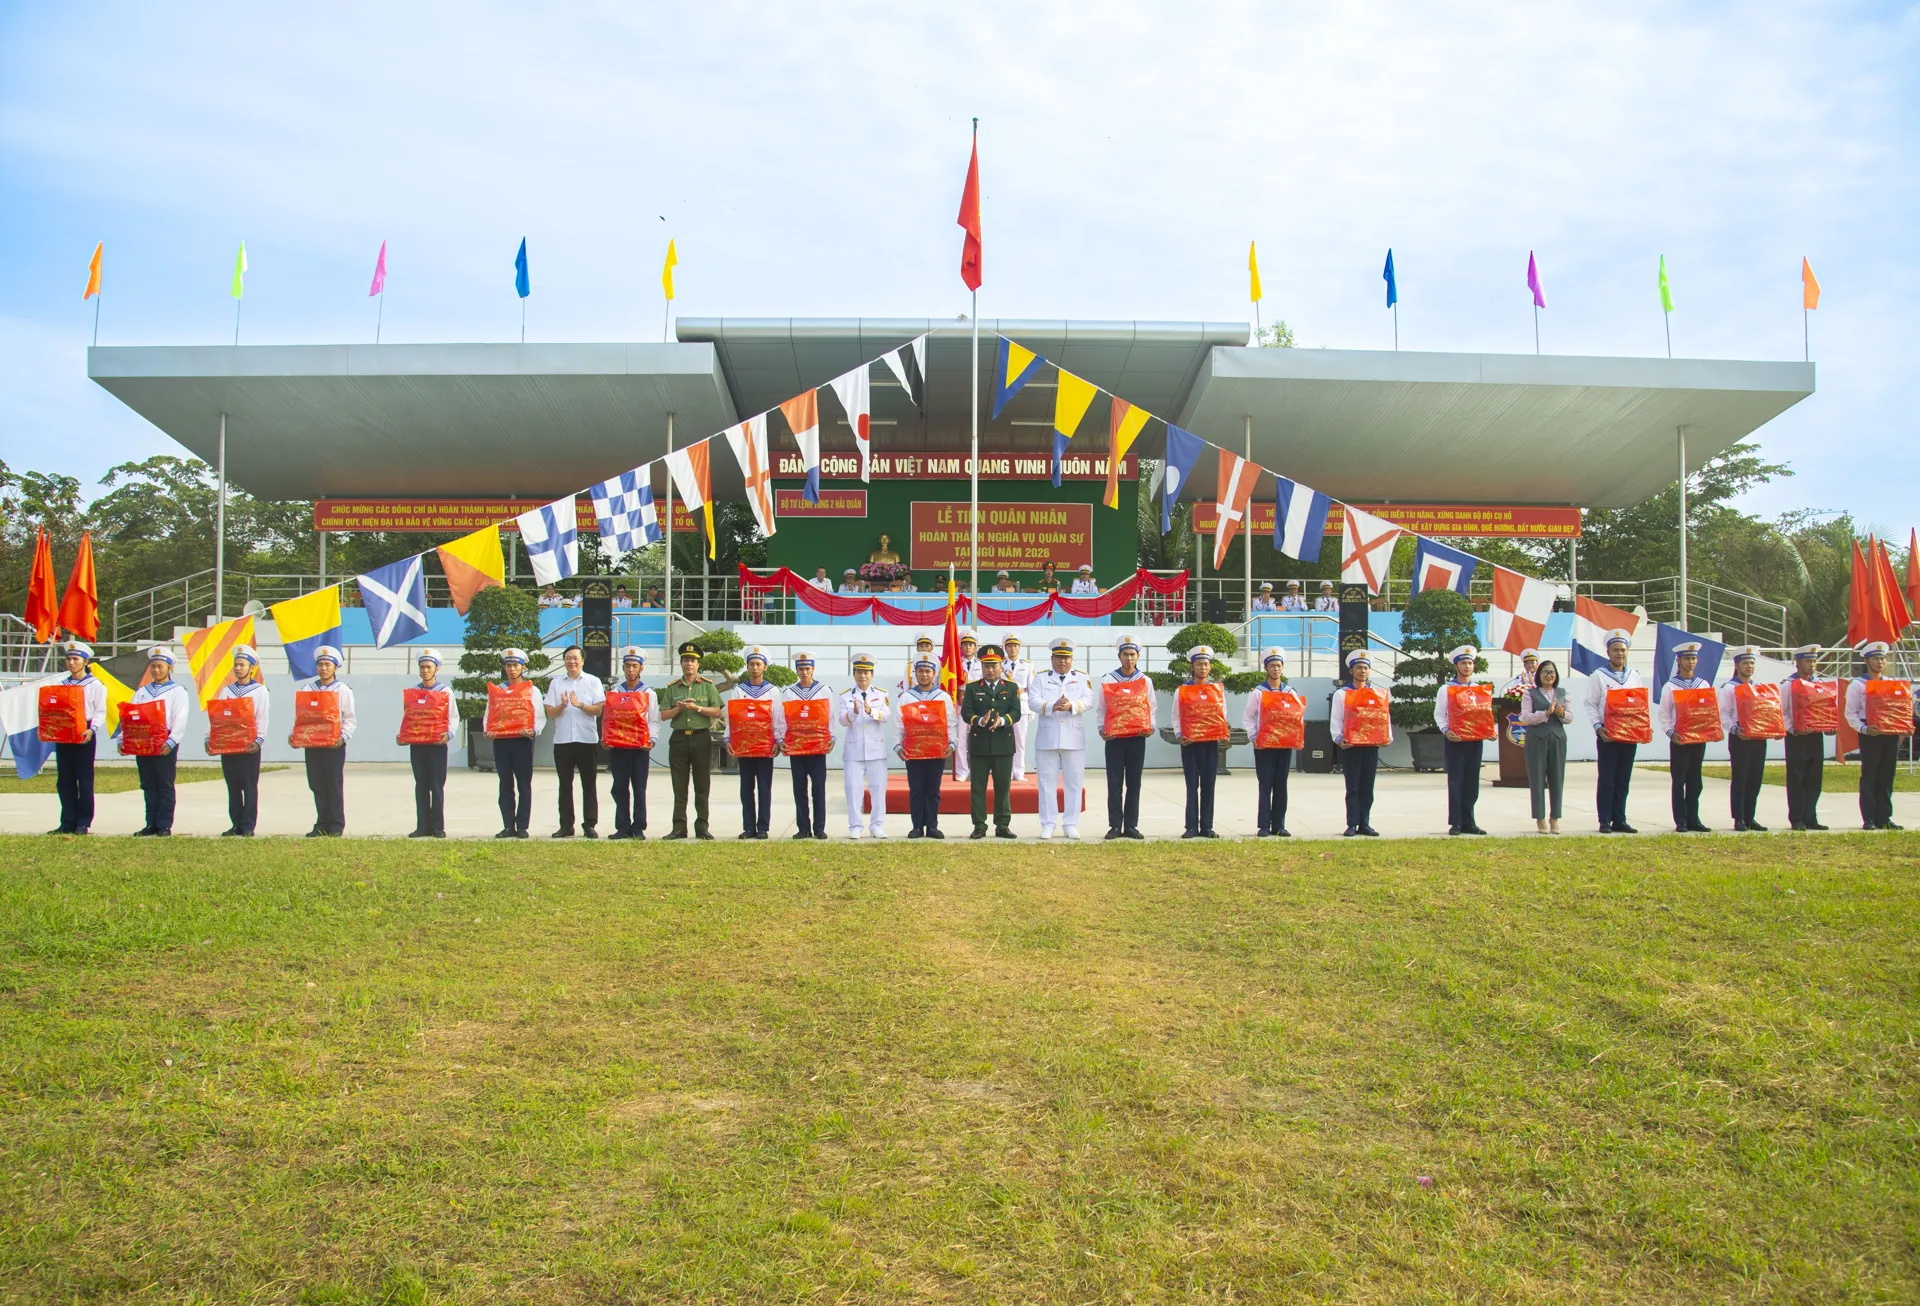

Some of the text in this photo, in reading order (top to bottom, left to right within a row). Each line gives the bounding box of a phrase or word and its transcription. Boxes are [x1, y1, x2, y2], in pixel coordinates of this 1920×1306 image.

[779, 454, 806, 473] ĐẢN
[821, 455, 857, 476] CỘNG
[895, 455, 923, 476] VIỆT
[927, 458, 960, 474] NAM
[1015, 459, 1046, 474] VINH
[332, 504, 351, 514] CHÚC
[375, 504, 390, 514] CÁC
[413, 504, 425, 514] CHÍ
[428, 505, 437, 514] ĐÃ
[439, 504, 459, 514] HOÀN
[461, 504, 484, 514] THÀNH
[486, 505, 508, 514] NGHĨA
[510, 505, 519, 515] VỤ
[831, 500, 835, 508] 2
[846, 498, 862, 509] QUÂN
[938, 505, 952, 524] LỄ
[990, 508, 1026, 525] QUÂN
[1030, 508, 1067, 525] NHÂN
[1265, 508, 1276, 517] TIẾ
[1406, 509, 1416, 519] TÀI
[1455, 511, 1472, 520] DANH
[321, 517, 344, 526] CHÍNH
[362, 516, 379, 527] HIỆN
[381, 518, 393, 527] ĐẠI
[394, 517, 404, 526] VÀ
[406, 516, 420, 526] BẢO
[422, 517, 431, 527] VỆ
[1452, 523, 1462, 531] GIA
[1563, 525, 1575, 534] ĐẸP
[919, 530, 1084, 545] HOÀN THÀH NGHĨA VỤ QUÂN SỰ
[955, 546, 971, 560] TẠI
[998, 546, 1022, 558] NĂM
[1025, 547, 1050, 558] 2026
